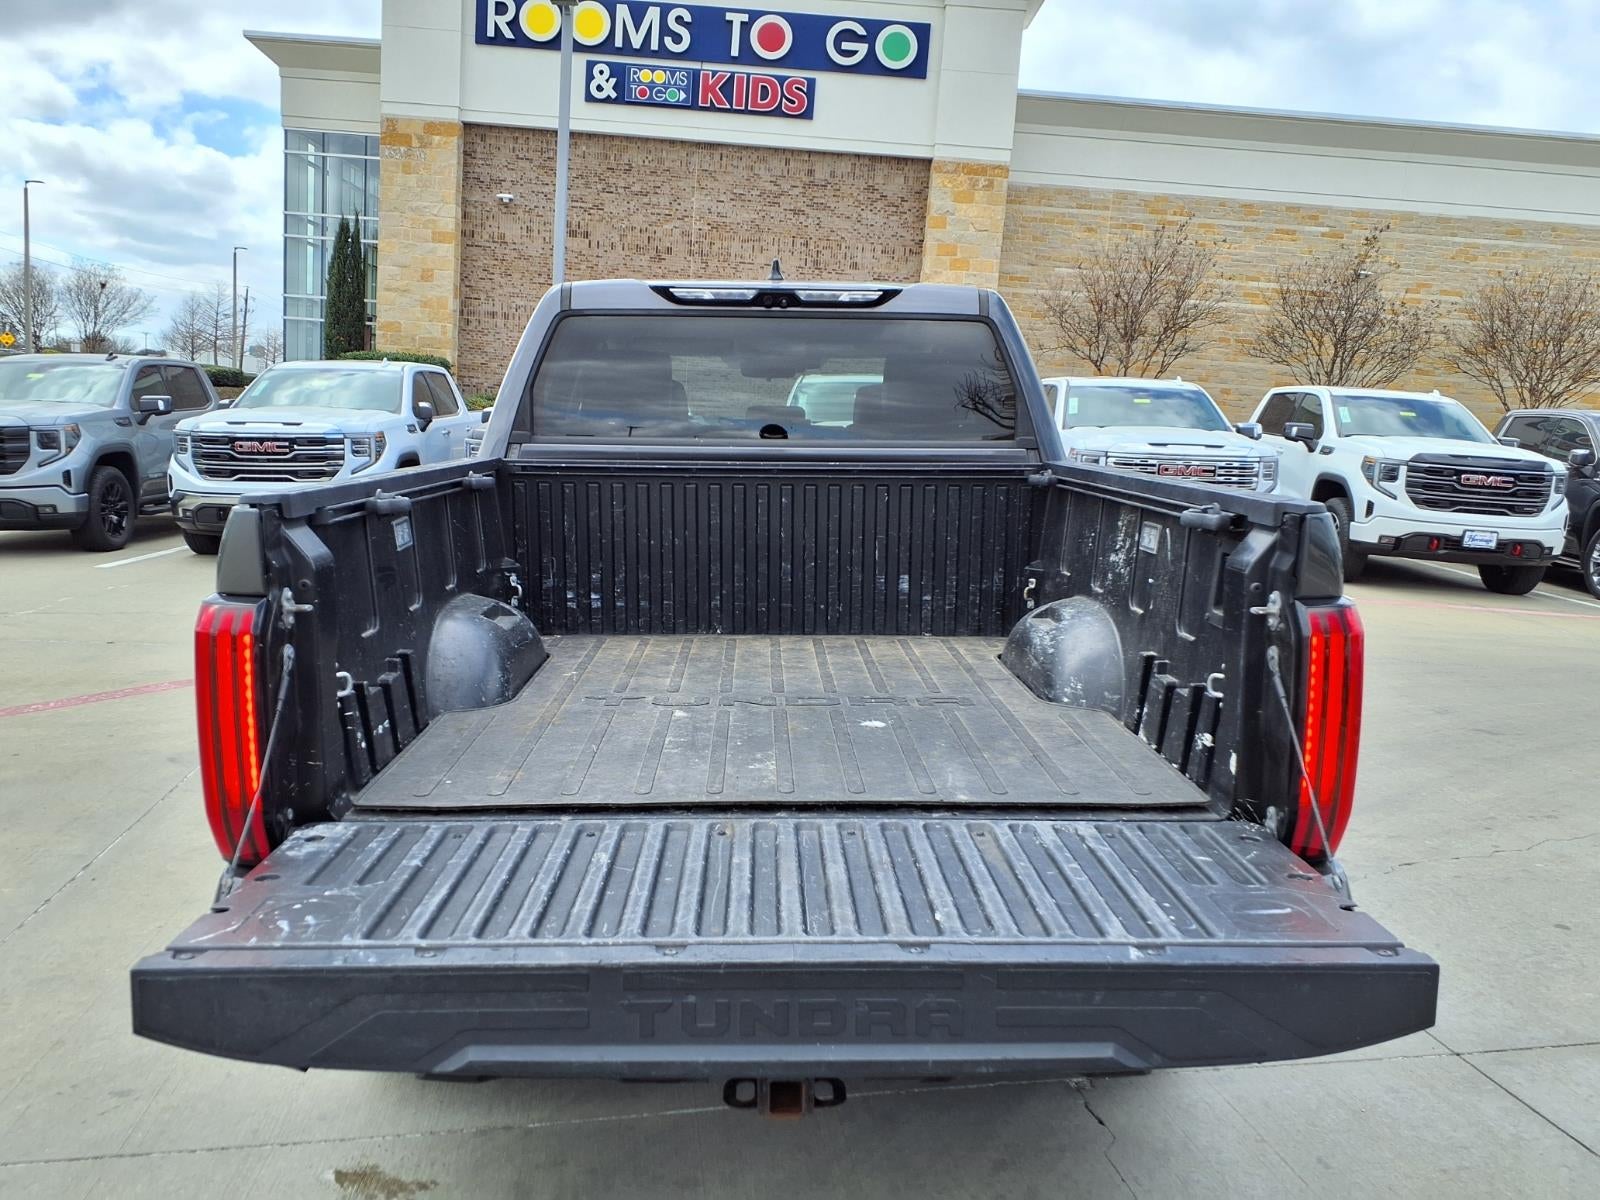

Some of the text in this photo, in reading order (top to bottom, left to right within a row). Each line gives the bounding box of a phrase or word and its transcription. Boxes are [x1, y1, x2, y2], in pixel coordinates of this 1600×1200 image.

[486, 0, 918, 70] ROOMS TO GO
[630, 68, 688, 86] ROOMS
[589, 63, 808, 115] & KIDS
[630, 85, 680, 102] TO GO
[234, 441, 290, 453] GMC
[1159, 464, 1215, 478] GMC
[1461, 474, 1515, 488] GMC
[621, 998, 966, 1038] TUNDRA
